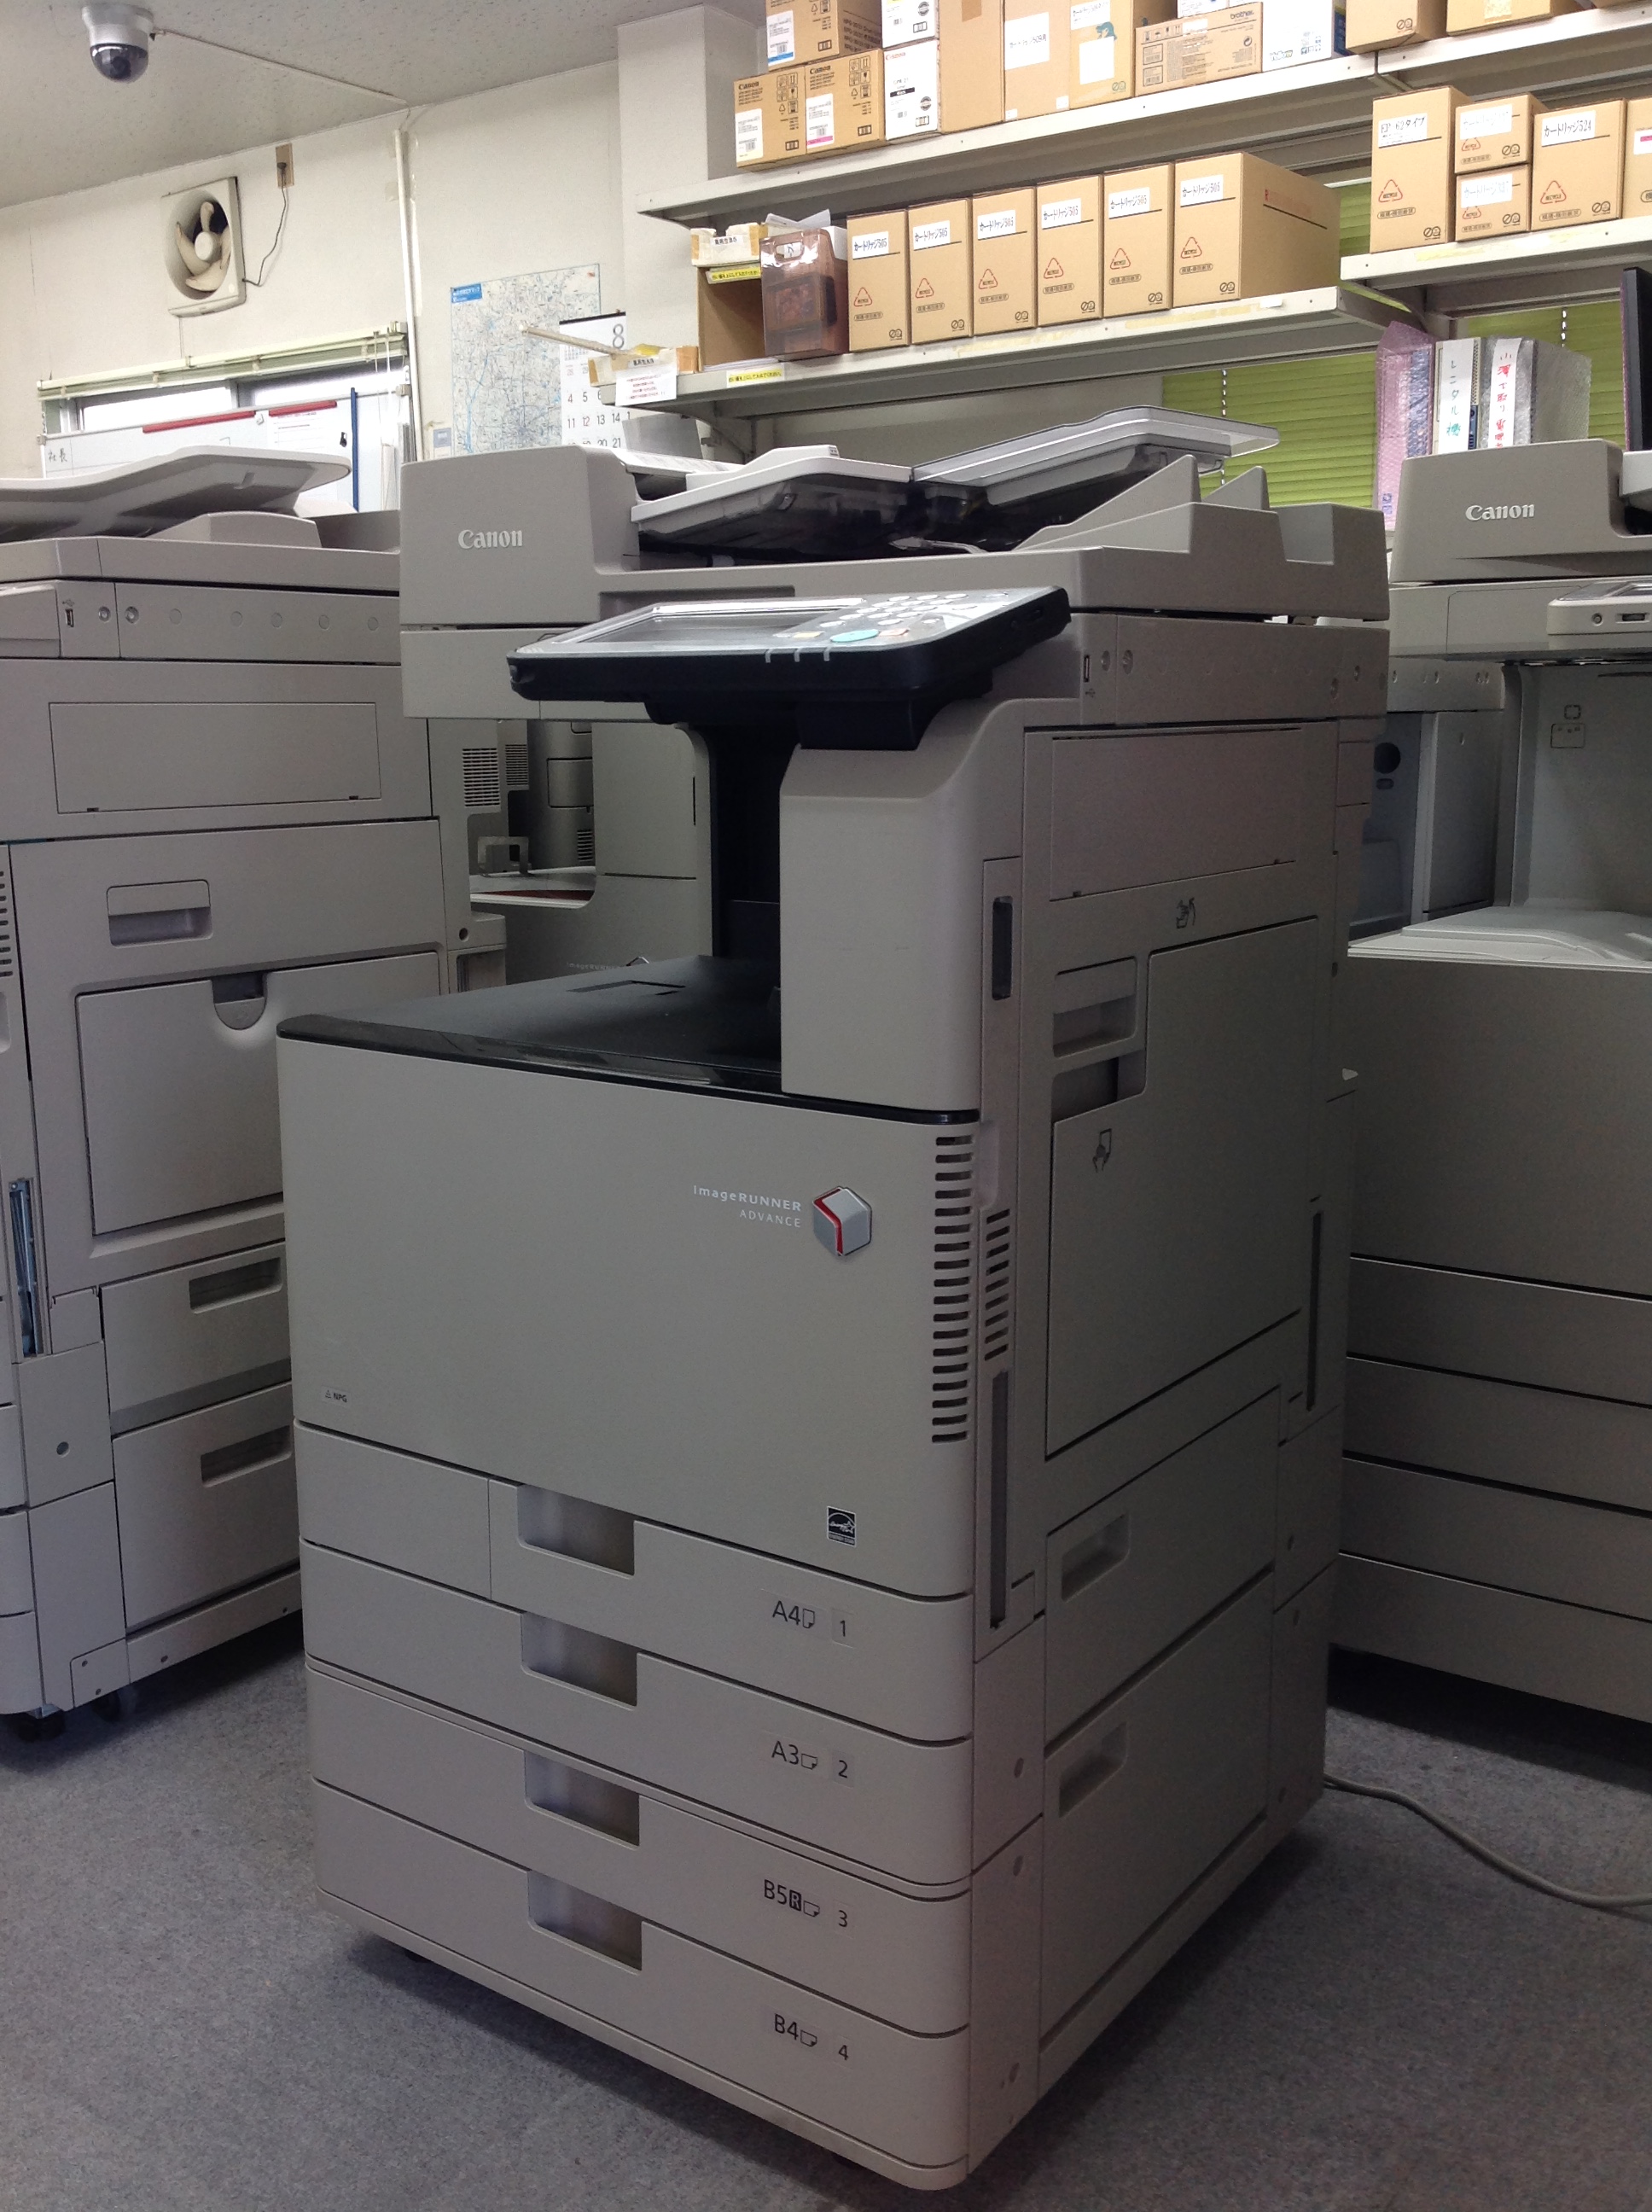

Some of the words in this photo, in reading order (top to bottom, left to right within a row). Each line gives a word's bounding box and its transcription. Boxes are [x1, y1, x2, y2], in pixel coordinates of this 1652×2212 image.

[1230, 10, 1254, 20] brother
[810, 65, 831, 74] Canon
[738, 81, 759, 90] Canon
[612, 323, 625, 350] 8
[567, 393, 573, 403] 4
[582, 392, 588, 403] 5
[567, 417, 575, 429] 11
[583, 416, 590, 428] 12
[597, 414, 606, 426] 13
[612, 412, 620, 424] 14
[1465, 504, 1535, 521] Canon
[457, 529, 522, 549] Canon
[740, 1208, 801, 1228] ADVANCE
[772, 1600, 800, 1626] A4
[840, 1620, 846, 1638] 1
[771, 1740, 800, 1765] A3
[838, 1760, 848, 1778] 2
[838, 1909, 848, 1928] 3
[774, 2013, 799, 2040] B4
[838, 2044, 849, 2061] 4
